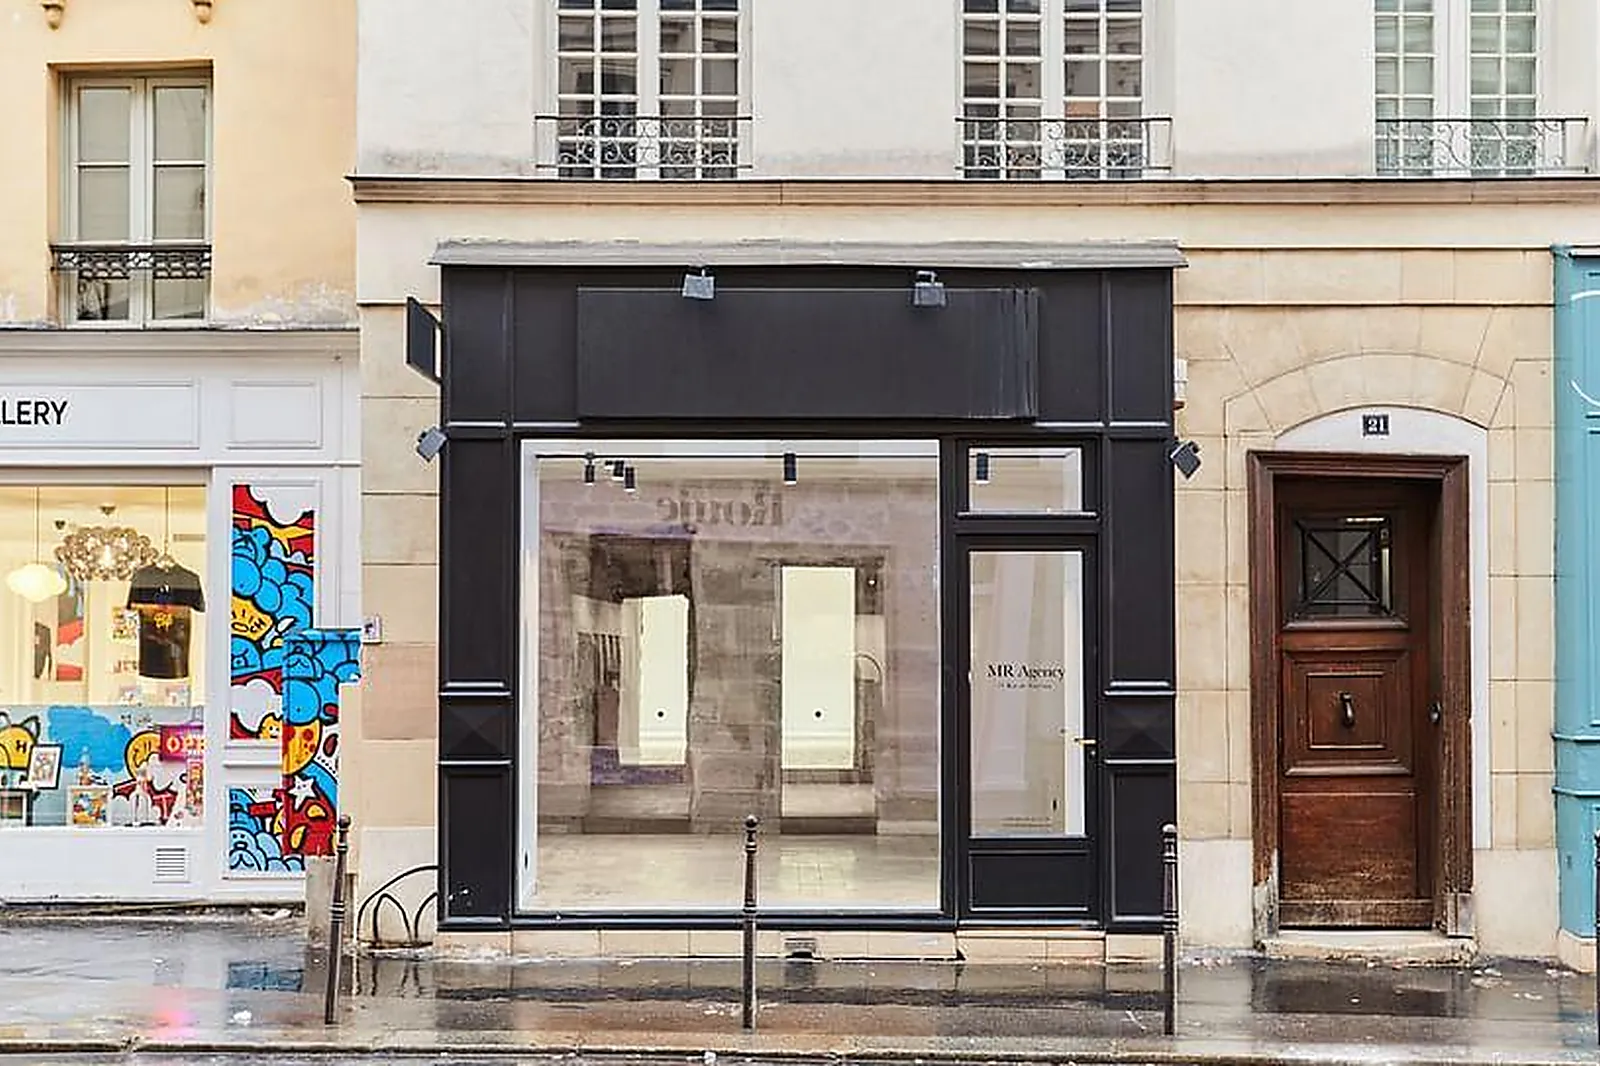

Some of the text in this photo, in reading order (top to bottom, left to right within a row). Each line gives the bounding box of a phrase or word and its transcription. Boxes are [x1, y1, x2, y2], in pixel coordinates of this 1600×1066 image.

[0, 400, 68, 425] LERY
[1368, 418, 1384, 432] 21
[986, 664, 1065, 682] MR Agency
